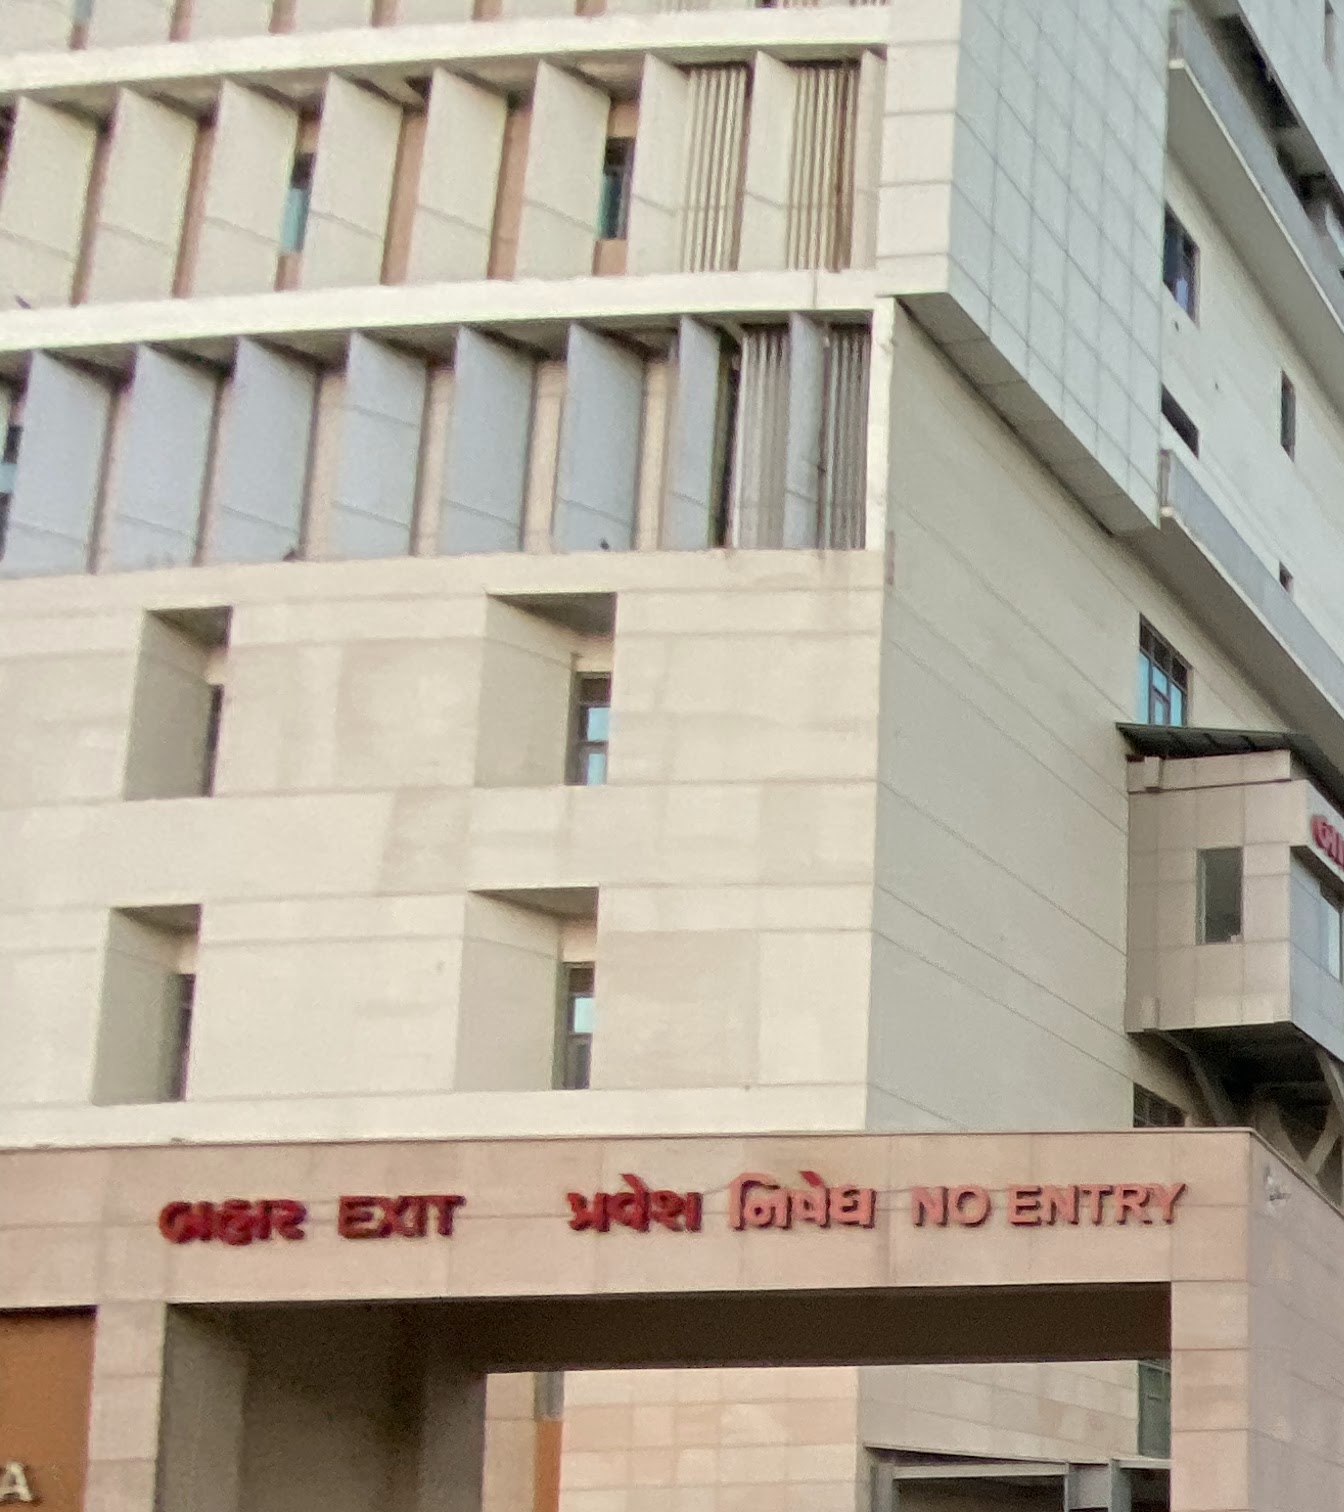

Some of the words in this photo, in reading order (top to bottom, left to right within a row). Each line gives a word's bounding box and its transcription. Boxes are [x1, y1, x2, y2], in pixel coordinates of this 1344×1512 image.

[338, 1194, 467, 1240] EXIT
[567, 1173, 702, 1232] પ્રવેશ
[730, 1171, 878, 1231] નિષેધ
[912, 1185, 993, 1230] NO
[1007, 1183, 1187, 1227] ENTRY
